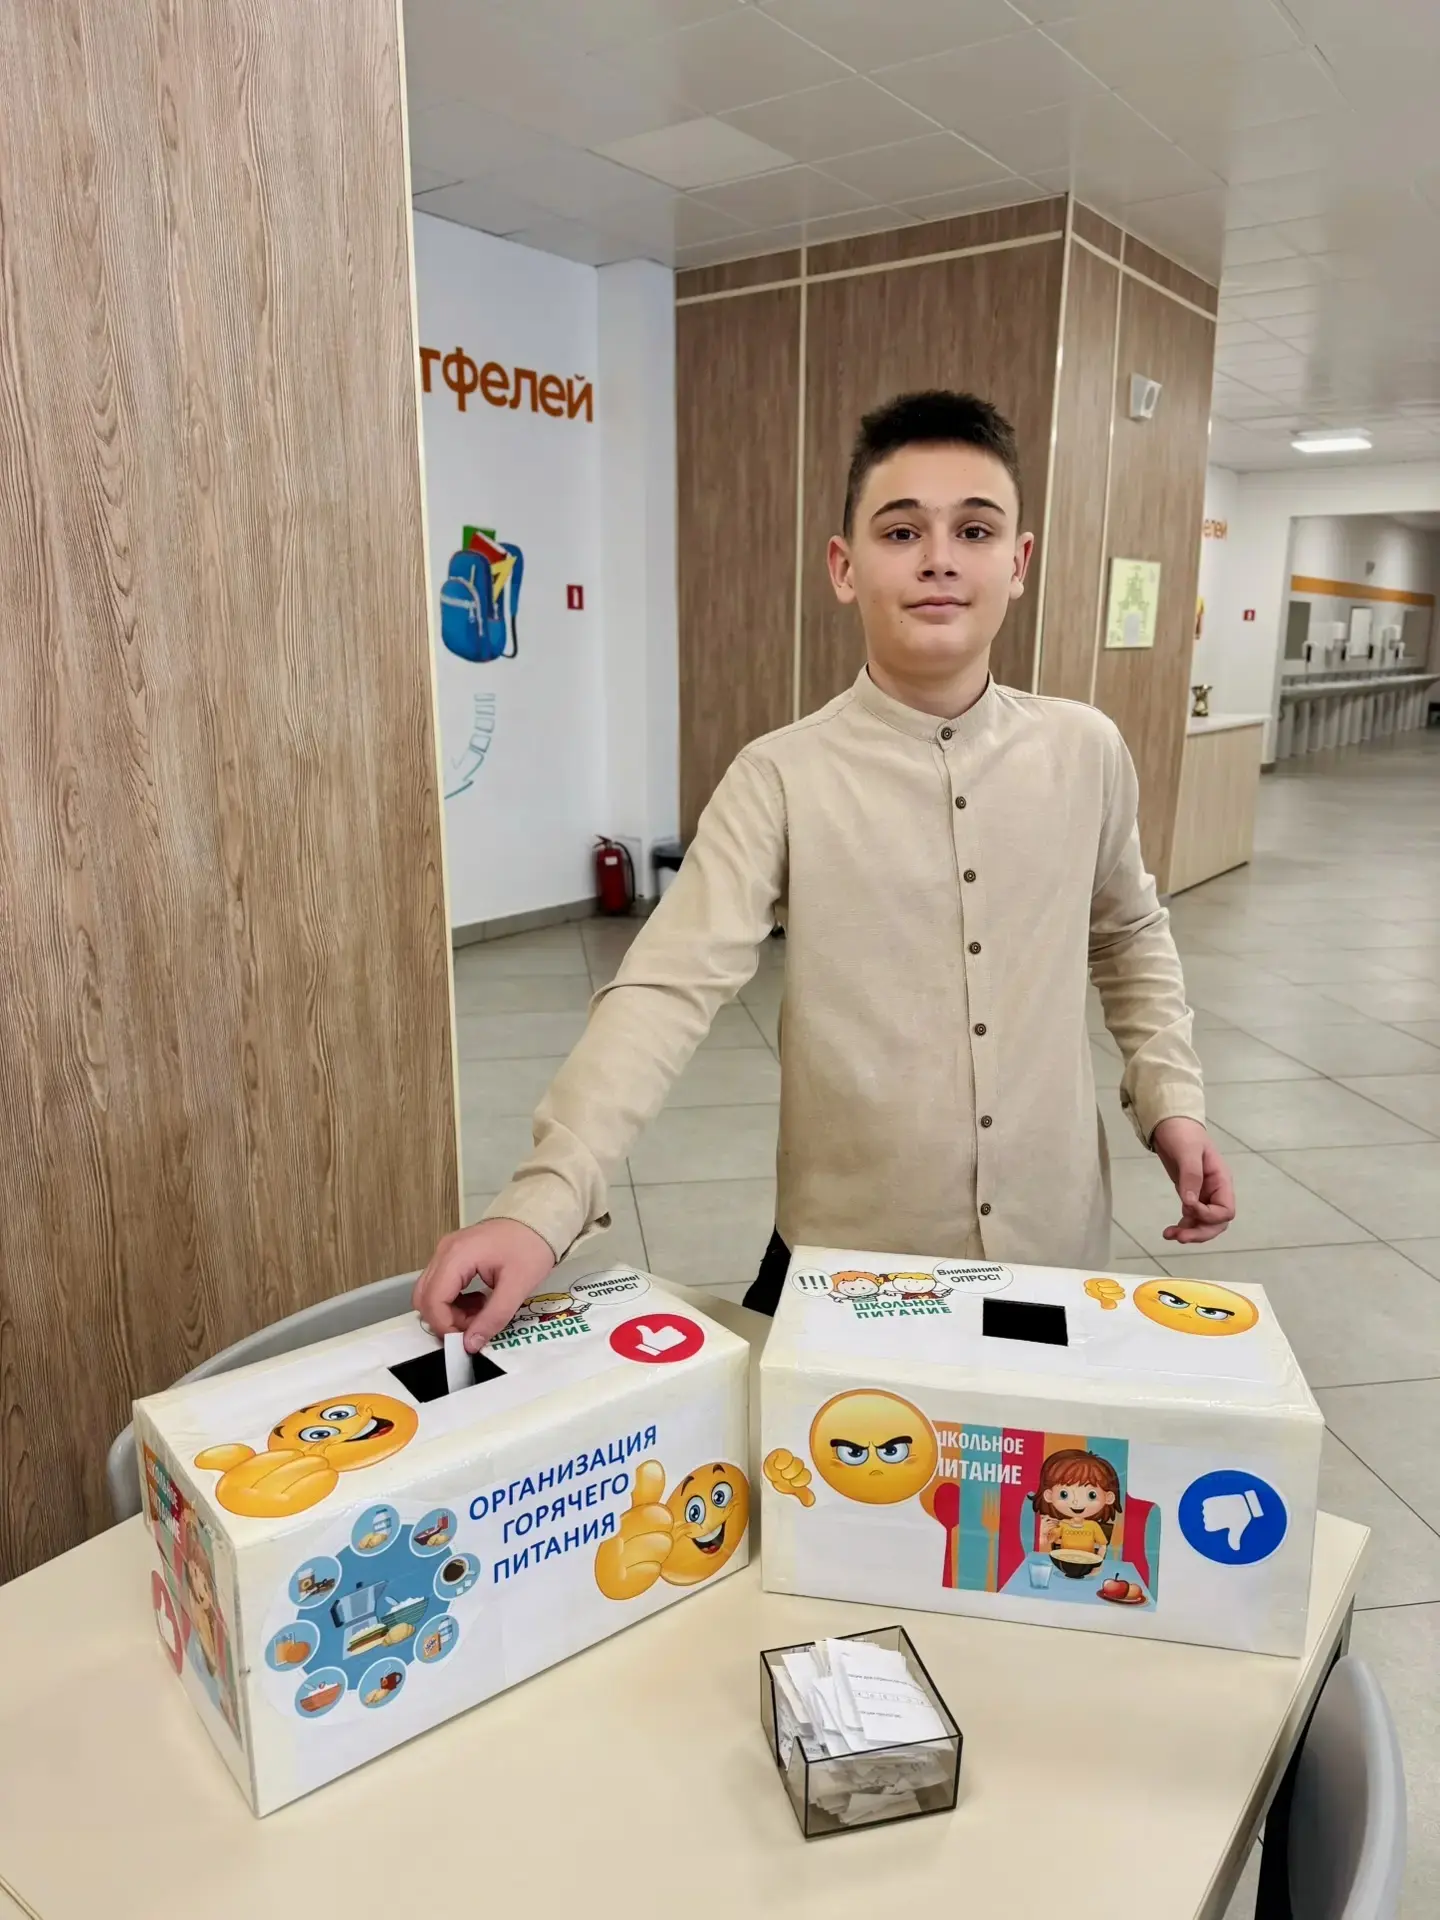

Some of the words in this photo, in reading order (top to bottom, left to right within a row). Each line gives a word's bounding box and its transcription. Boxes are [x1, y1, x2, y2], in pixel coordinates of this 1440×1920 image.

[937, 1266, 1003, 1276] Внимание!
[950, 1274, 1001, 1283] ОПРОС!
[573, 1274, 640, 1292] Внимание!
[587, 1283, 638, 1298] ОПРОС!
[854, 1299, 948, 1311] ШКОЛЬНОЕ
[856, 1306, 952, 1319] ПИТАНИЕ
[492, 1324, 591, 1350] ПИТАНИЕ
[469, 1425, 656, 1520] ОРГАНИЗАЦИЯ
[503, 1473, 629, 1544] ГОРЯЧЕГО
[493, 1512, 615, 1583] ПИТАНИЯ
